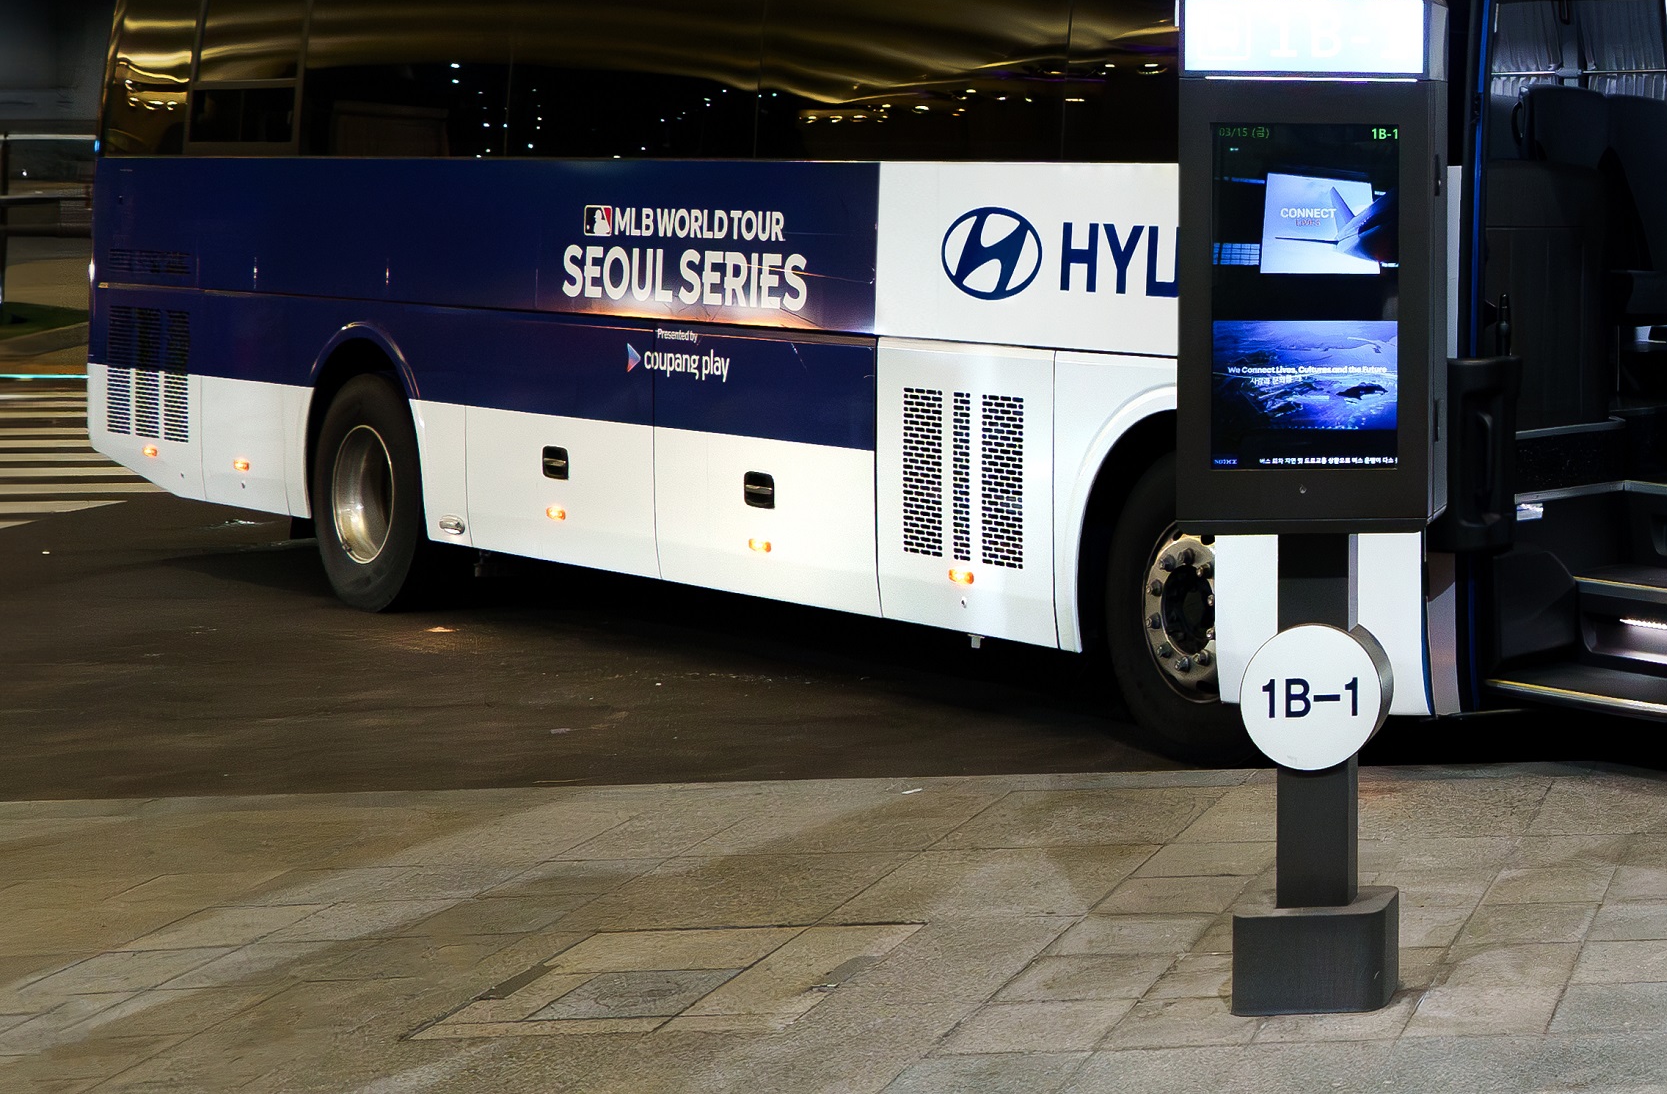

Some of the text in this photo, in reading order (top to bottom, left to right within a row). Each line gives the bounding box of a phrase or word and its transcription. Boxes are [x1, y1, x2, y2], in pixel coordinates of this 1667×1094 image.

[1219, 127, 1248, 137] 03/15
[1371, 128, 1399, 140] 1B-1
[614, 207, 785, 242] MLB WORLD TOUR
[1280, 208, 1337, 219] CONNECT
[1060, 222, 1180, 298] HYU
[562, 244, 807, 311] SEOUL SERIES
[656, 328, 698, 343] Presented by
[643, 349, 730, 383] coupang play
[1241, 366, 1276, 374] Connect
[1262, 677, 1358, 719] 1B-1
